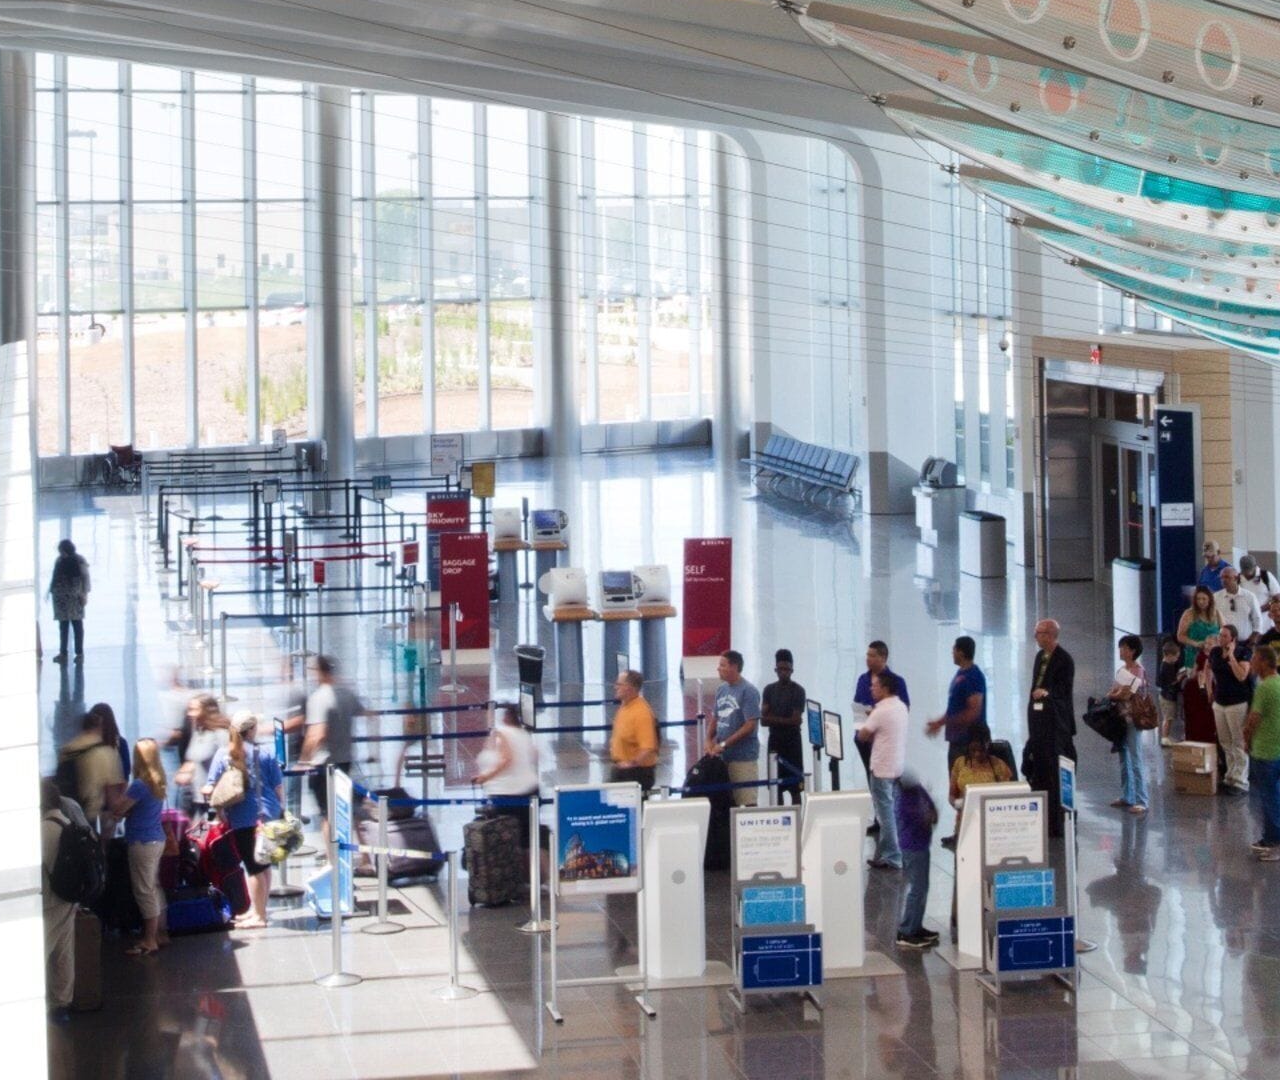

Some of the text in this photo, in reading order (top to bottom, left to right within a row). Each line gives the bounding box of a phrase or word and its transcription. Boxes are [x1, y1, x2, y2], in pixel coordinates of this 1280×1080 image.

[427, 517, 465, 525] PRIORITY
[442, 567, 462, 575] DROP
[685, 565, 706, 575] SELF
[740, 818, 780, 826] UNITED
